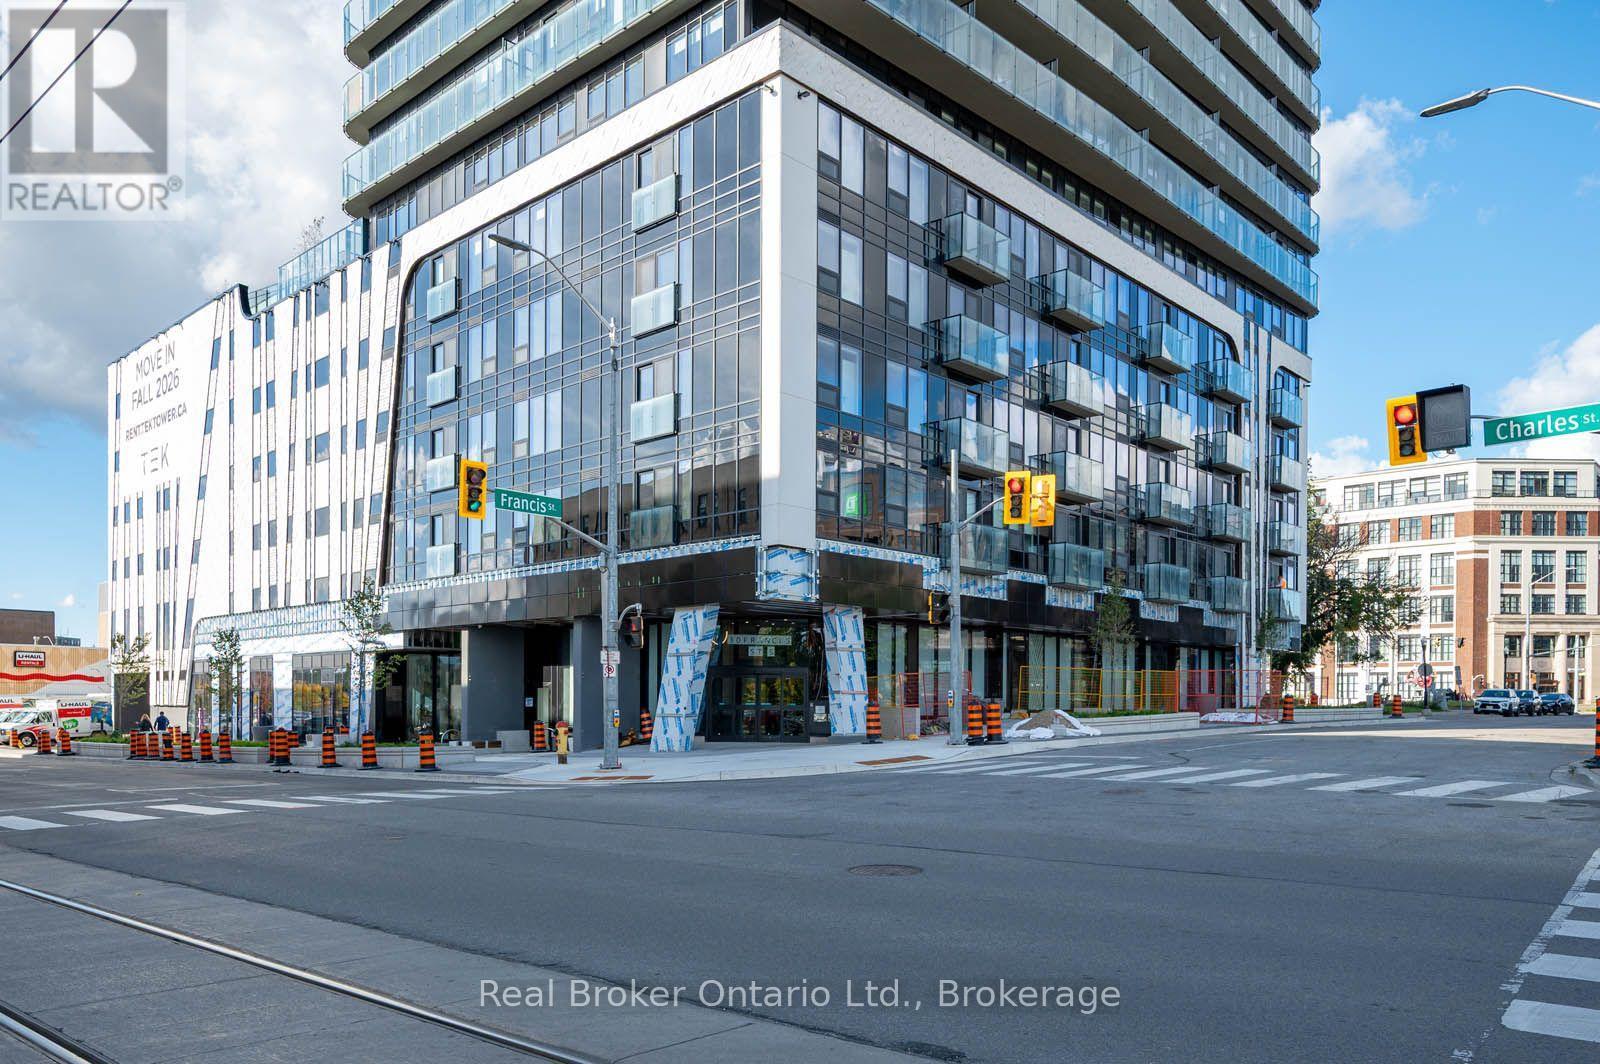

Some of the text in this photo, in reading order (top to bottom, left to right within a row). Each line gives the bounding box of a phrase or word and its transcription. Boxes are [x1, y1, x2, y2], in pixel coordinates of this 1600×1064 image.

[136, 340, 176, 382] MOVE IN
[132, 367, 180, 411] FALL 2026
[1495, 414, 1579, 440] Charles
[141, 442, 169, 476] TEK
[501, 493, 547, 513] Francis
